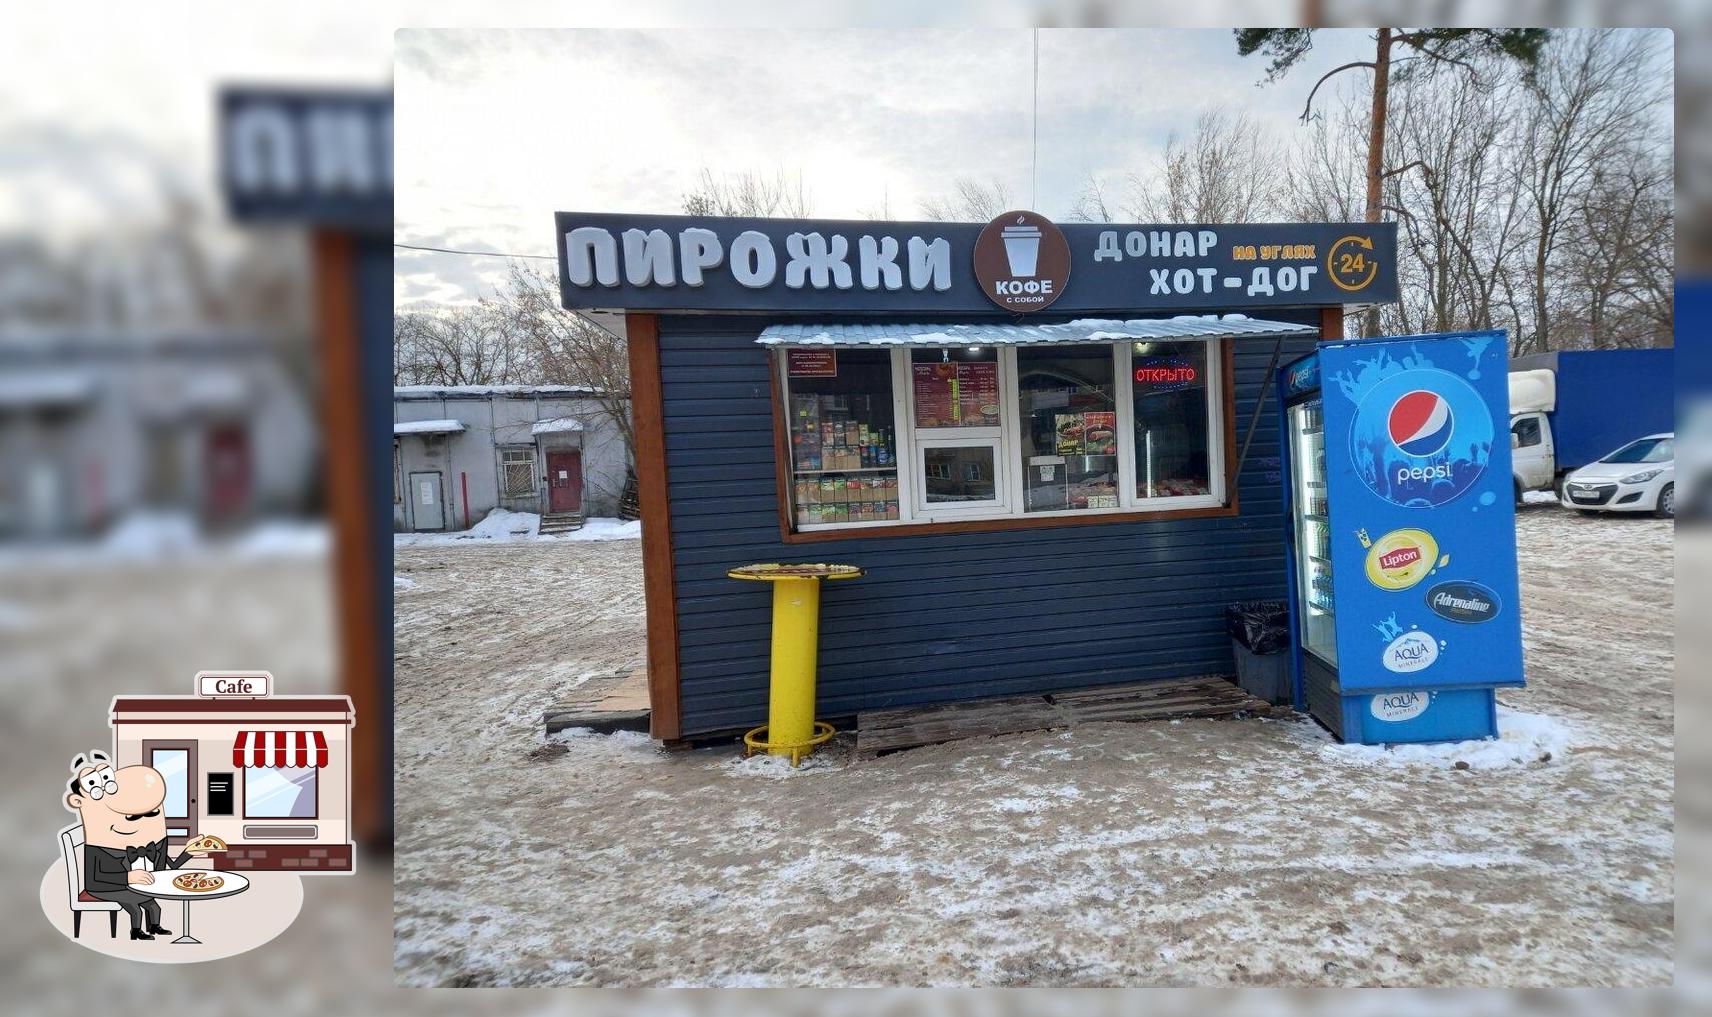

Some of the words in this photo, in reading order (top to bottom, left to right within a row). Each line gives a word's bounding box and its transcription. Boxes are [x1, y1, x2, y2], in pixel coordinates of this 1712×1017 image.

[1094, 231, 1218, 262] ДОНАР
[1232, 246, 1257, 261] НА
[1260, 244, 1317, 261] УГЛЯХ
[565, 227, 952, 291] ПИРОЖКИ
[1340, 253, 1365, 273] 24
[995, 280, 1053, 295] КОФЕ
[1136, 368, 1195, 382] ОТКРЫТО
[1397, 461, 1451, 485] pepsi
[1382, 551, 1418, 566] Lipton
[1433, 592, 1490, 613] Adrenaline
[1394, 643, 1429, 661] AQUA
[1383, 691, 1419, 709] AQUA
